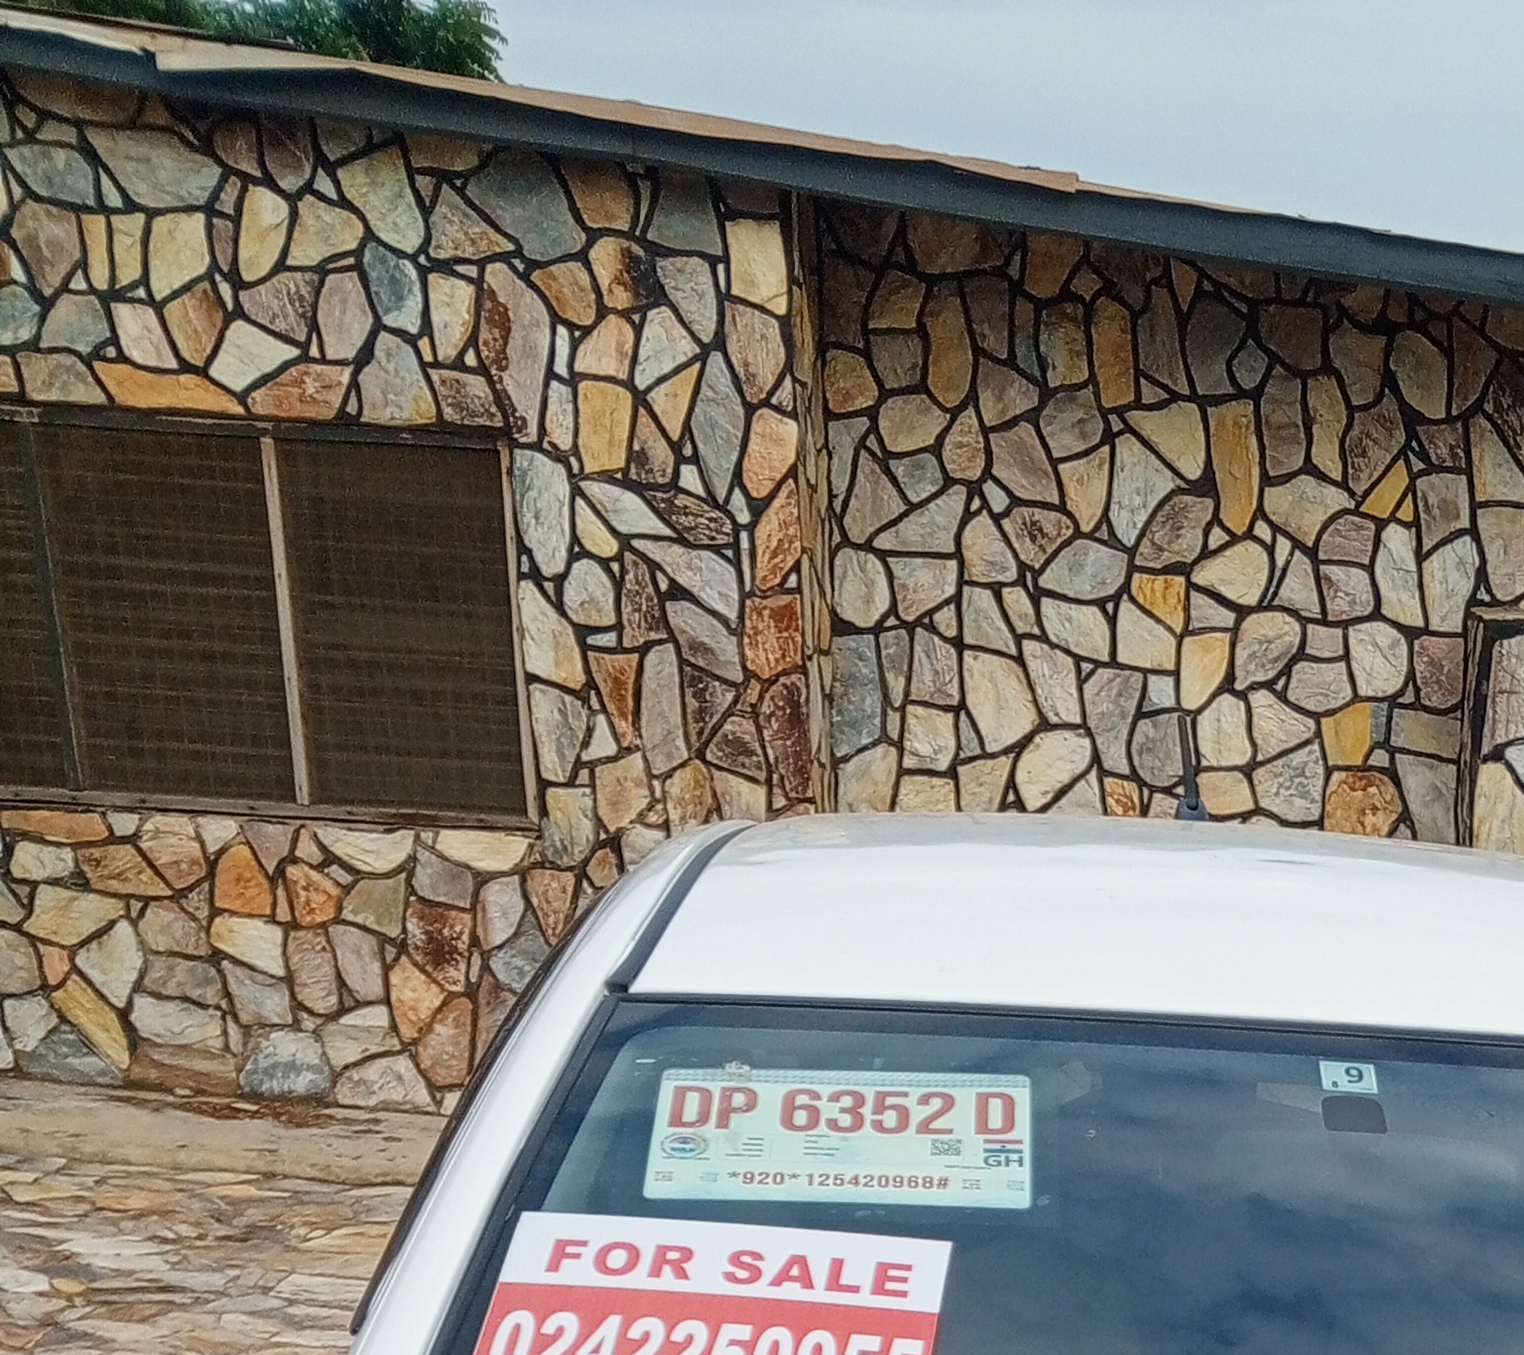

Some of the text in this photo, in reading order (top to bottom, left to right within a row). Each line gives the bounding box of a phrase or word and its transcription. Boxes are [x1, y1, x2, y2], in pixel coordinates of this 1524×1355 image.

[1344, 1066, 1364, 1084] 9
[667, 1085, 1016, 1135] DP 6352 D
[982, 1154, 1024, 1168] GH
[544, 1239, 913, 1299] FOR SALE
